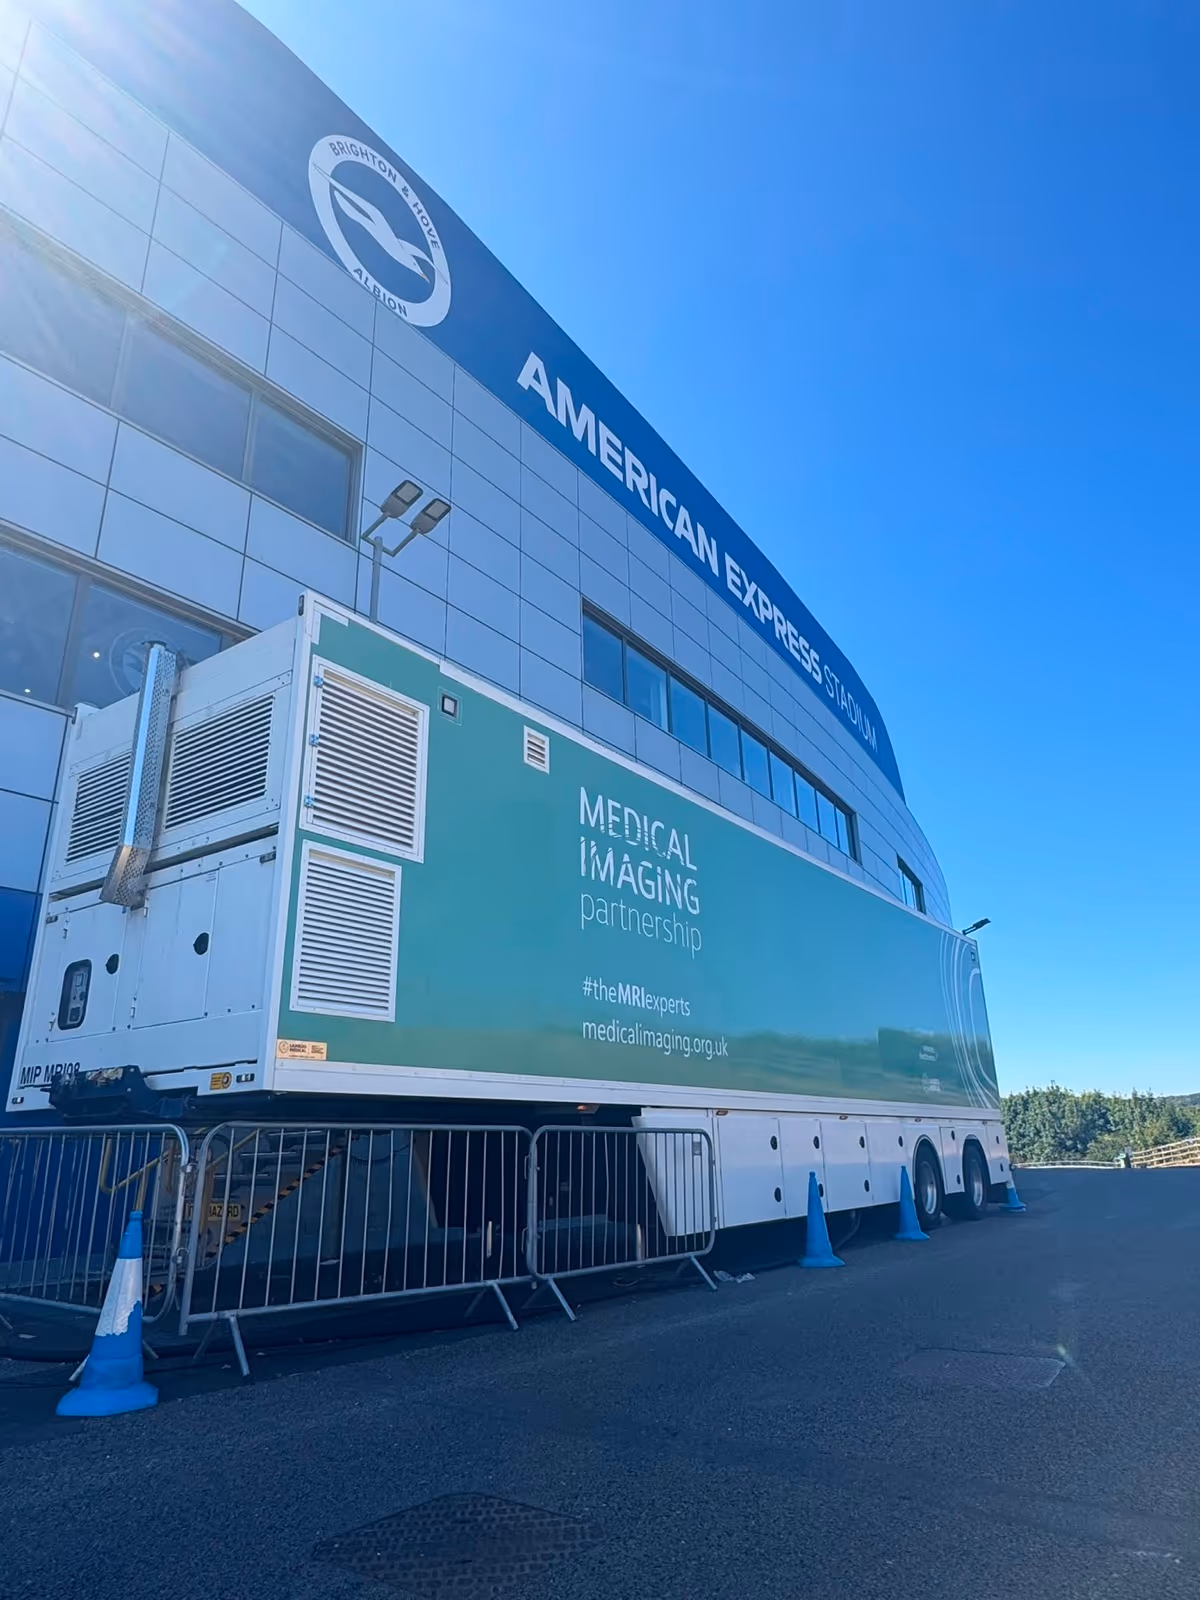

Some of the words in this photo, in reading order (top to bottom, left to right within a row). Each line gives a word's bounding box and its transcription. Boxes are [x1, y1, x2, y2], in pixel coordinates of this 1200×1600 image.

[329, 142, 398, 184] BRIGHTON
[401, 186, 410, 198] &
[412, 202, 441, 250] HOVE
[353, 267, 408, 318] ALBION
[516, 351, 719, 577] AMERICAN
[725, 552, 823, 685] EXPRESS
[823, 664, 878, 755] STADIUM
[580, 786, 698, 871] MEDICAL
[580, 836, 700, 915] IMAGING
[580, 892, 702, 960] partnership
[582, 976, 691, 1018] #theMRIexperts
[582, 1019, 729, 1060] medicalimaging.org.uk
[20, 1066, 42, 1085] MIP
[207, 1205, 239, 1218] AZRD
